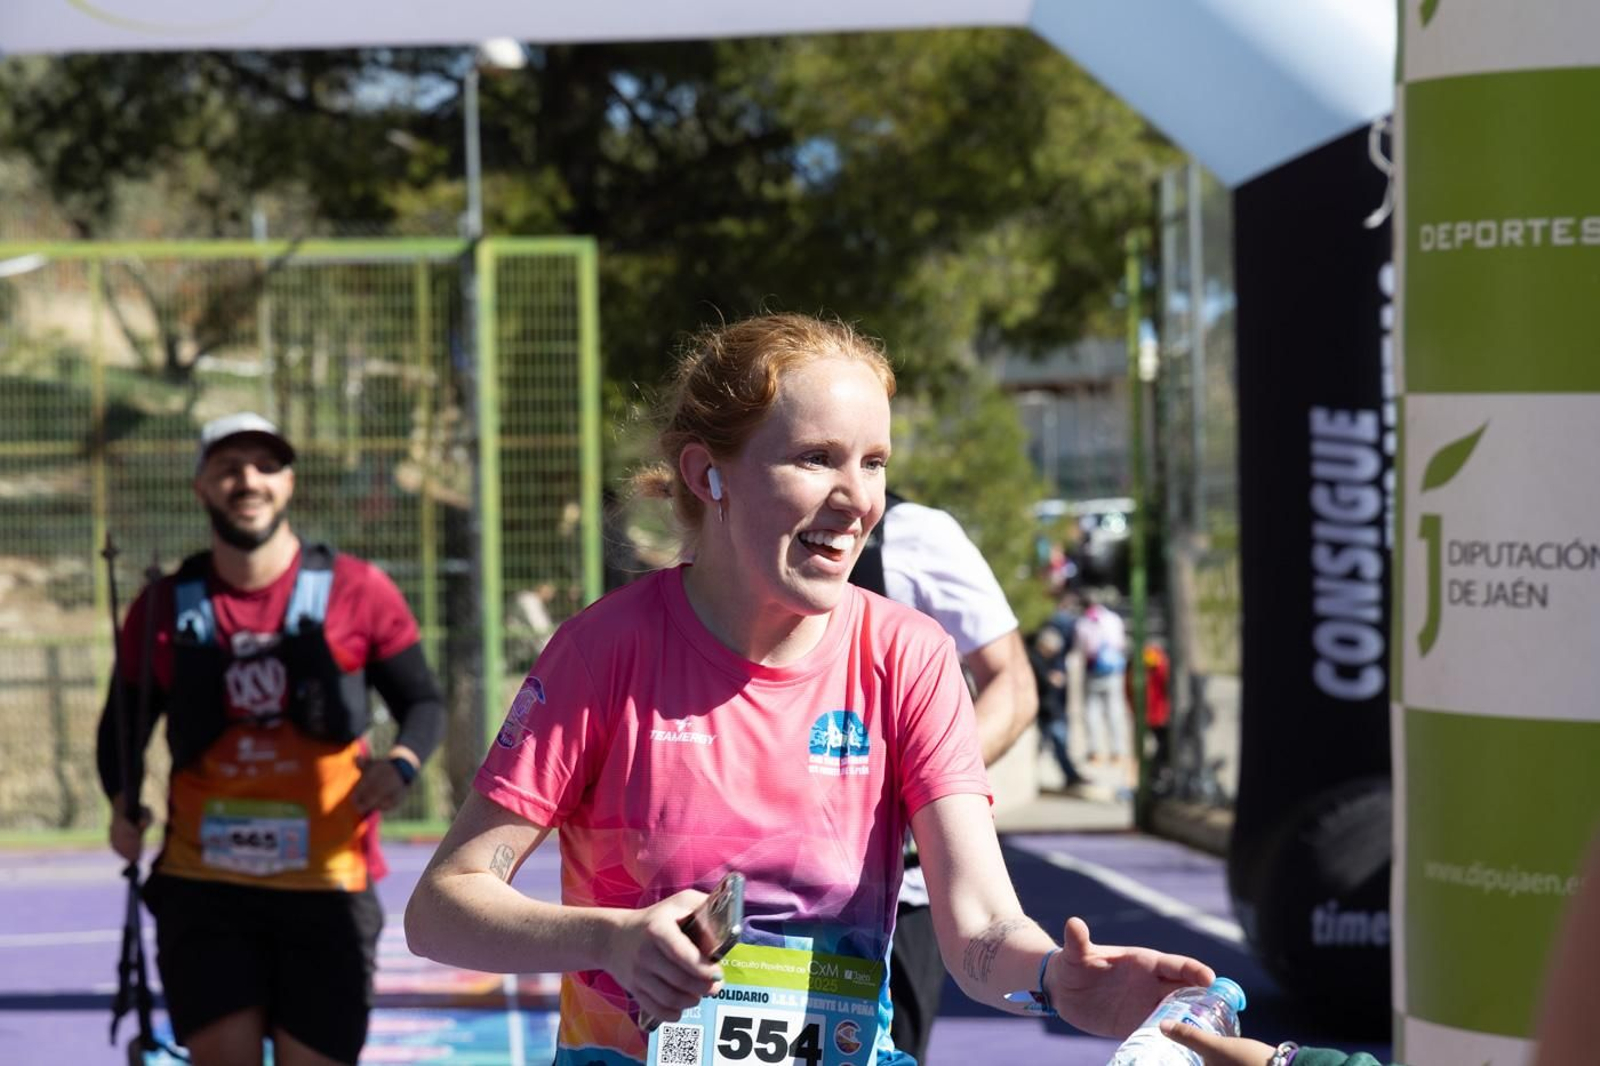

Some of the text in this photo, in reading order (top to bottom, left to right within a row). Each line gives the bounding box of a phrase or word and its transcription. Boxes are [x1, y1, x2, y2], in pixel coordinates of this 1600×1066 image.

[1419, 216, 1600, 251] DEPORTES
[1309, 405, 1386, 700] CONSIGUE
[1448, 577, 1549, 609] DE JAÉN
[731, 960, 759, 970] Circuito
[808, 961, 839, 978] CxM
[851, 1000, 875, 1016] PEÑA
[717, 1015, 823, 1066] 554
